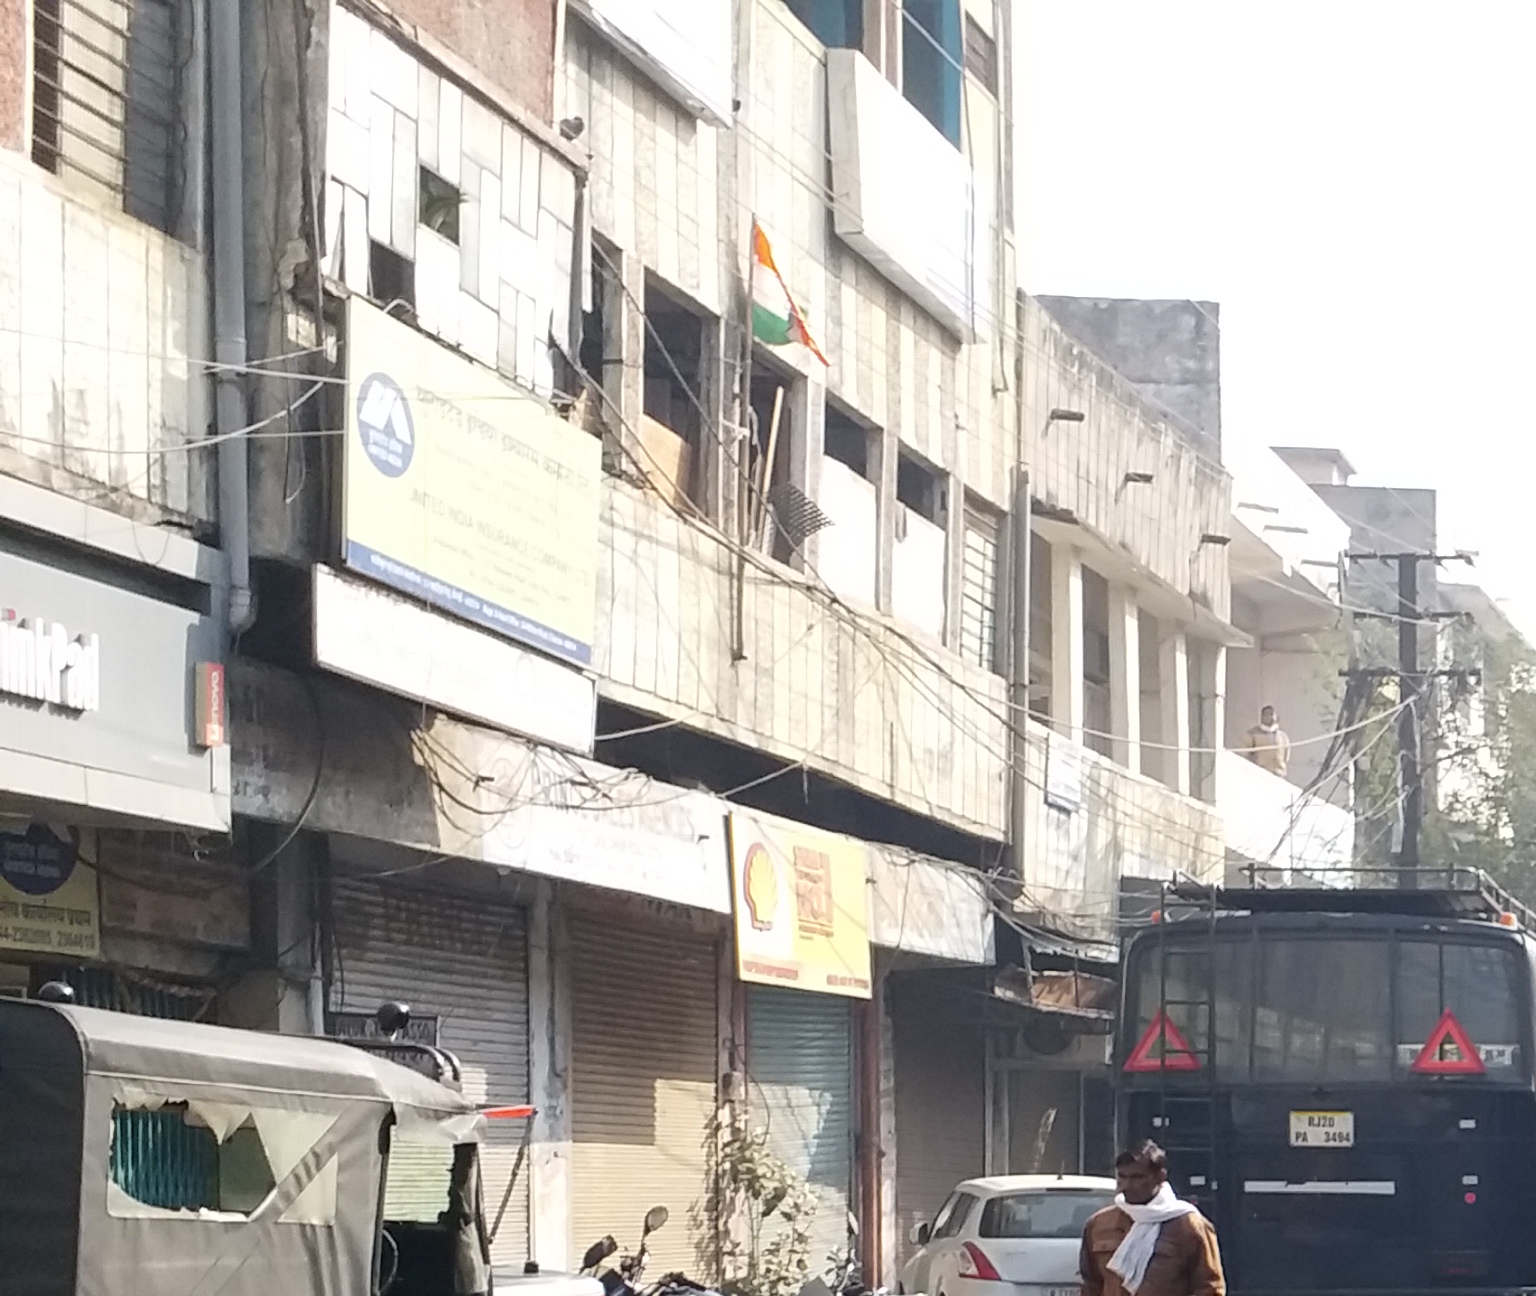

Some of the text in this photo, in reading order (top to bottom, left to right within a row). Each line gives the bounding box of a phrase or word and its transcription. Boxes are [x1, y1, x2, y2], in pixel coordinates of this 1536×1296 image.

[448, 506, 474, 529] INDIA
[1307, 1115, 1336, 1129] RJ20
[1295, 1131, 1309, 1144] PA
